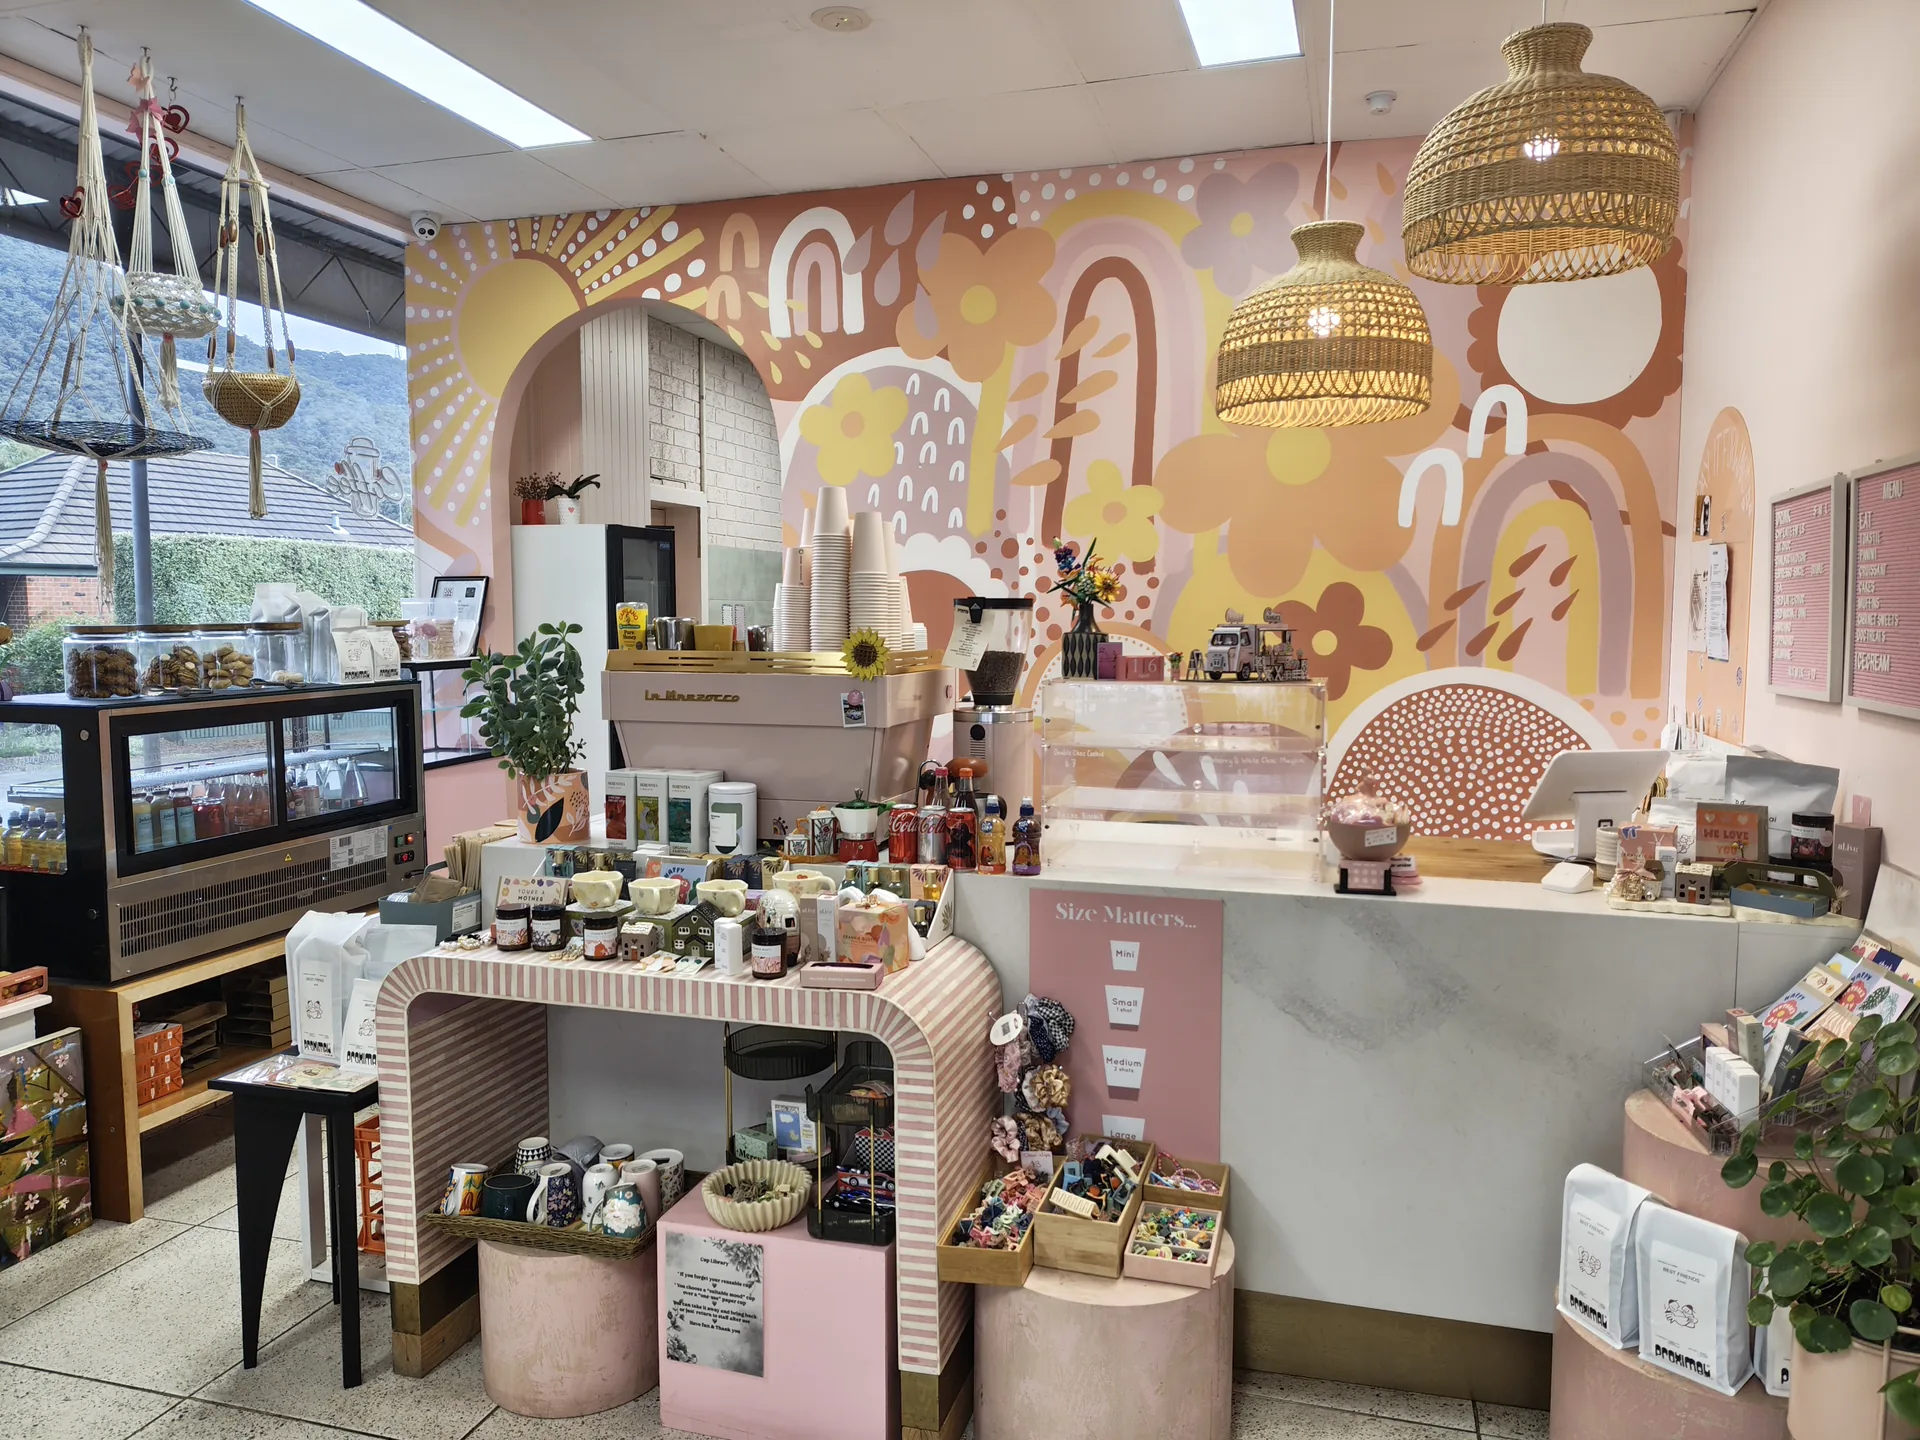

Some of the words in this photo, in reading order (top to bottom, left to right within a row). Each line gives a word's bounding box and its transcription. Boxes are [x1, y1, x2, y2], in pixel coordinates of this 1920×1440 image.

[1859, 511, 1873, 530] EAT
[1704, 828, 1719, 838] WE
[1724, 830, 1749, 840] LOVE
[1056, 902, 1098, 922] Size
[1116, 949, 1135, 959] Mini
[1112, 998, 1138, 1007] Small
[1106, 1057, 1142, 1068] Medium
[1110, 1130, 1137, 1140] Large
[711, 1258, 728, 1267] Library
[1663, 1267, 1676, 1275] BEST
[1677, 1272, 1700, 1283] FRIENDS
